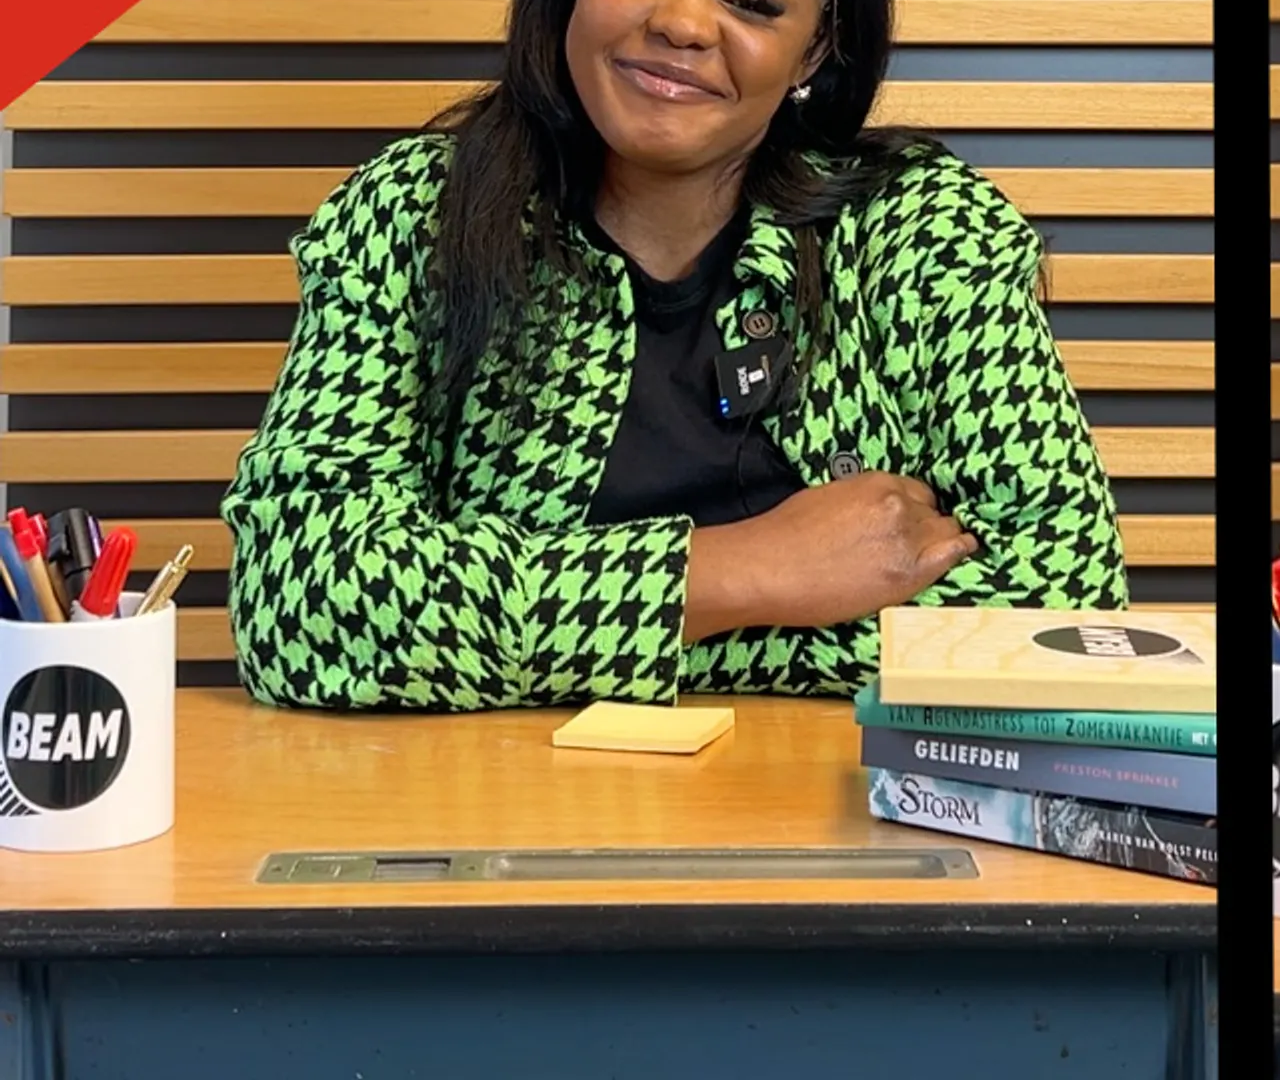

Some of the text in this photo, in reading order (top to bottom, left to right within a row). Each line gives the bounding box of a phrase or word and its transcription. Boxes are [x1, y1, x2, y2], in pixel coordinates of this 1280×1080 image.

[6, 708, 123, 761] BEAM
[1034, 716, 1056, 735] TOT
[1065, 718, 1183, 746] ZOMERVAKANTIE
[914, 739, 1020, 771] GELIEFDEN
